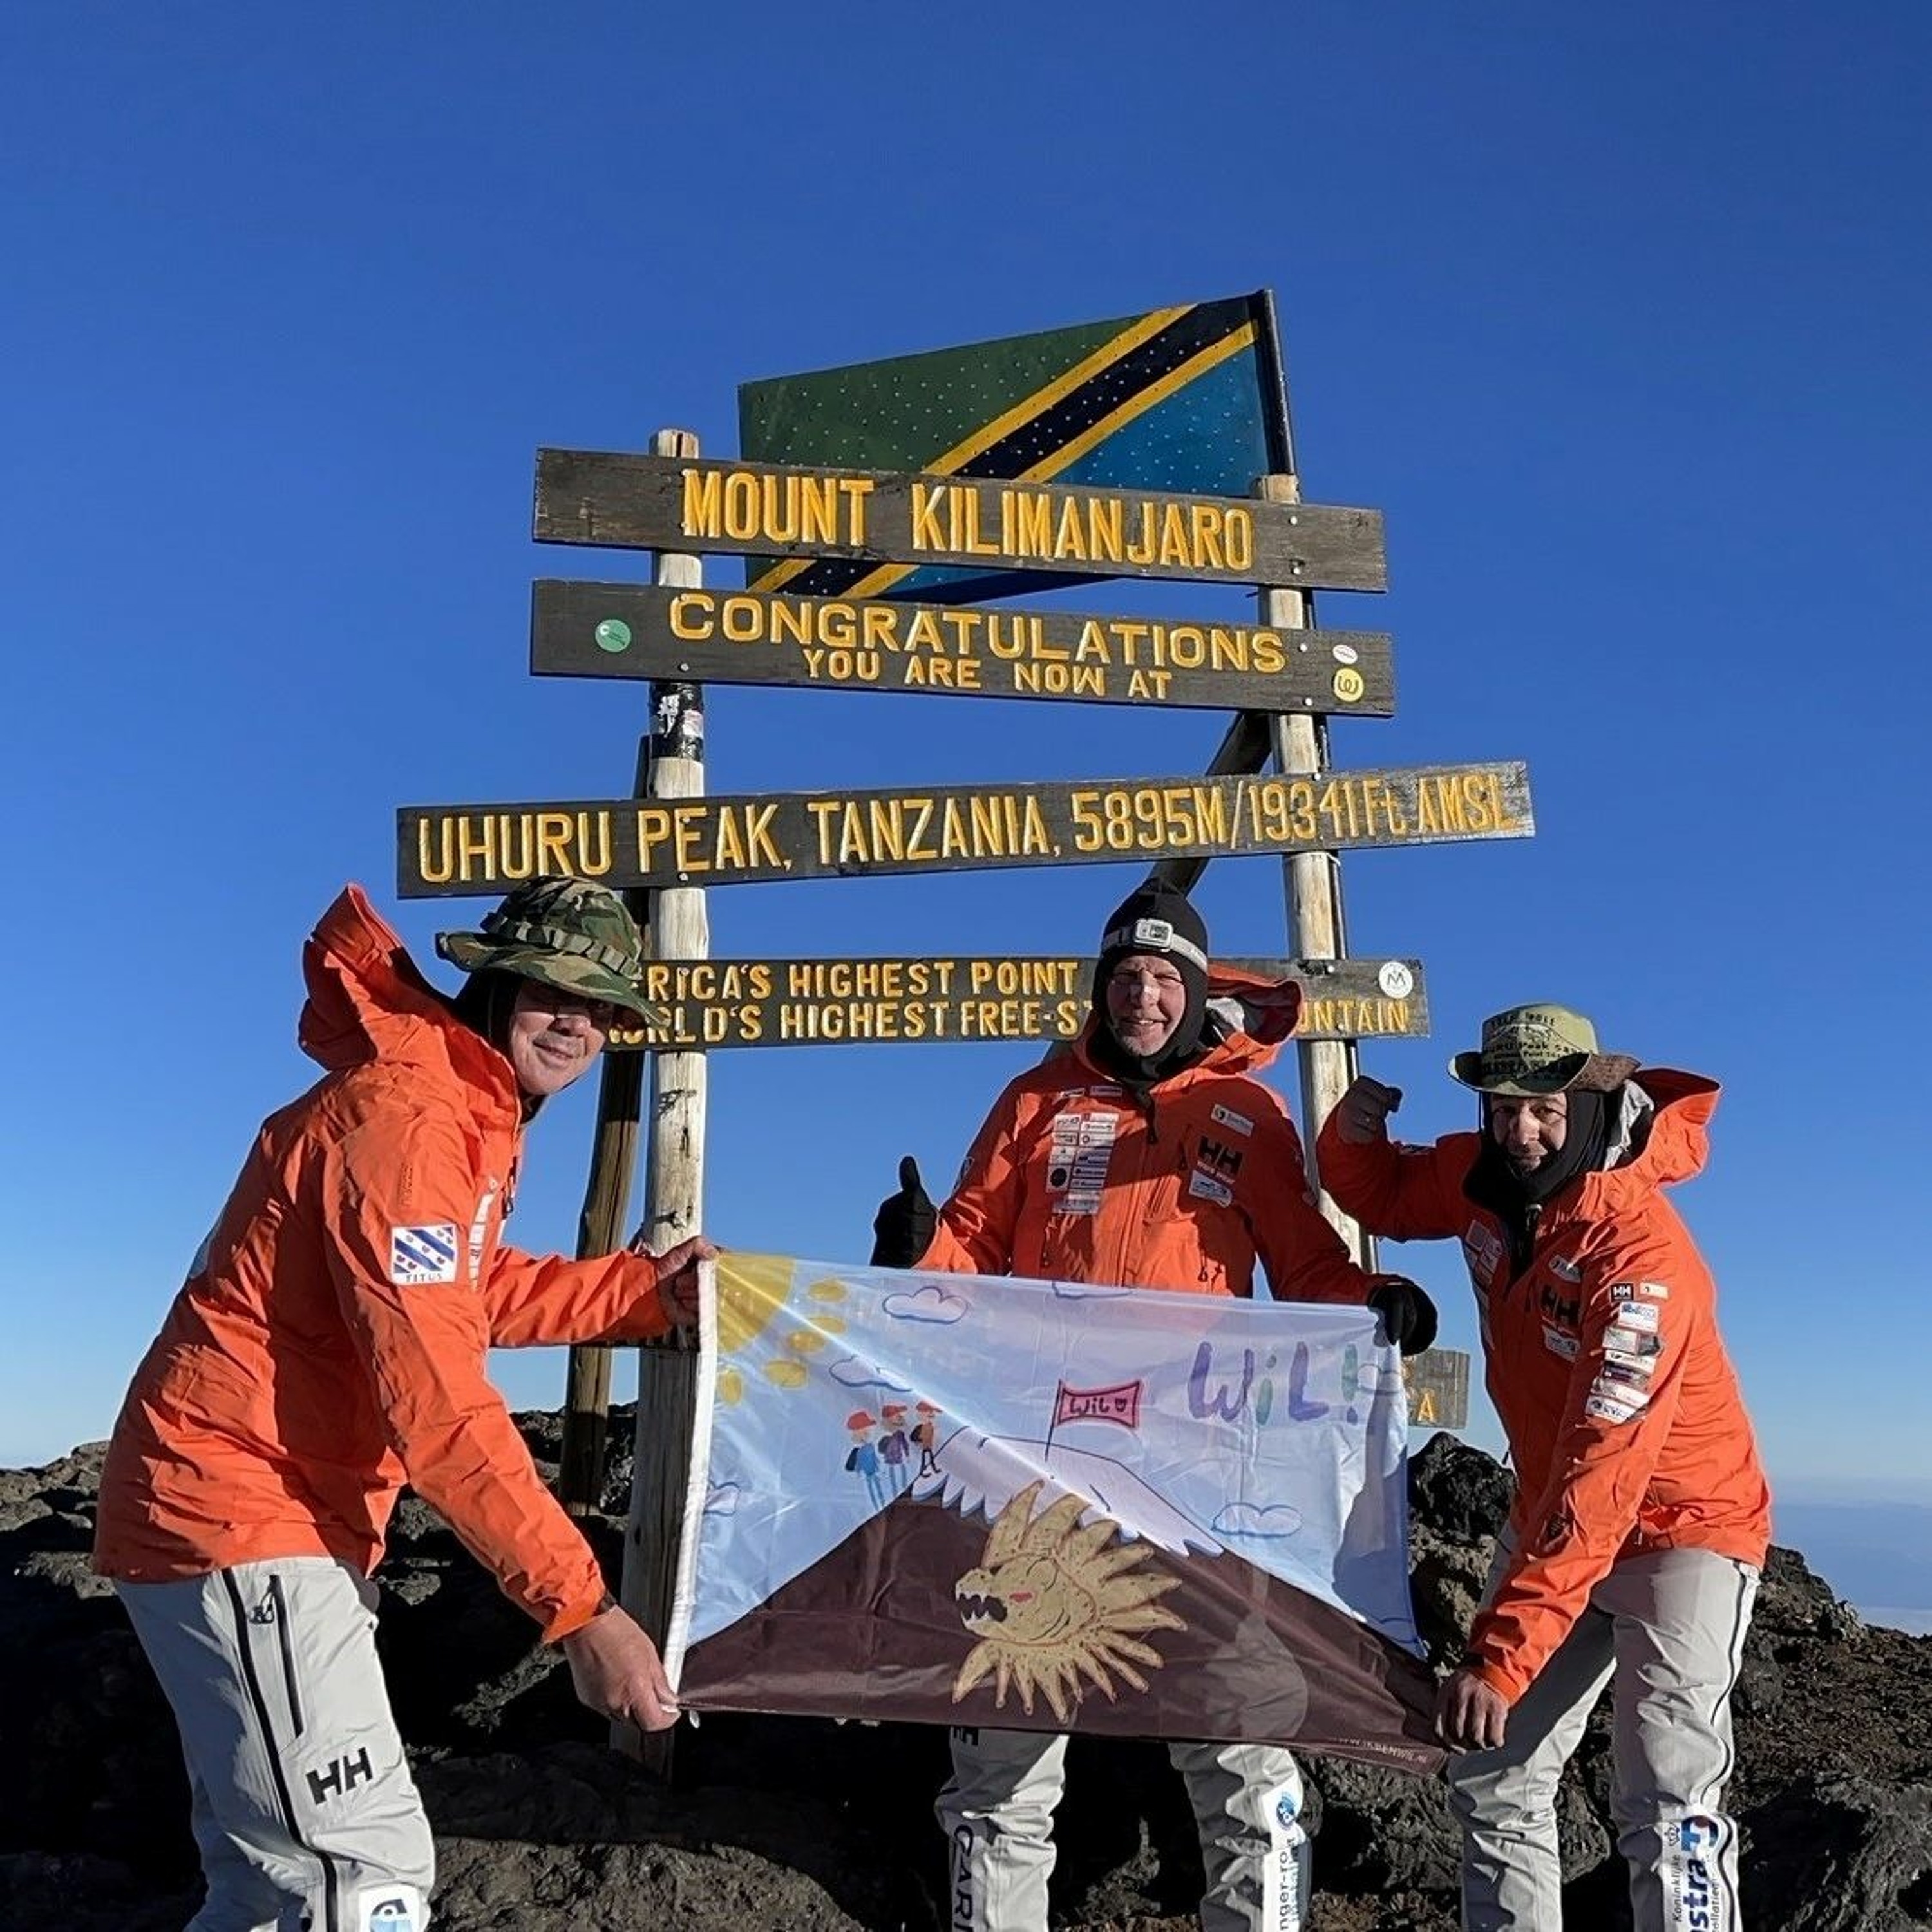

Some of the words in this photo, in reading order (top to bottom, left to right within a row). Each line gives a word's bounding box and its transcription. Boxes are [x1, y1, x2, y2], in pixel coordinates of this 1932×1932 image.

[683, 469, 874, 546] MOUNT
[911, 483, 1253, 571] KILIMANJARO
[670, 593, 1286, 674] CONGRATULATIONS
[803, 649, 880, 680] YOU
[904, 655, 981, 689] ARE
[1014, 663, 1105, 696] NOW
[1128, 670, 1172, 699] AT
[419, 811, 611, 882] UHURU
[638, 804, 793, 873] PEAK,
[808, 795, 1061, 864] TANZANIA,
[1418, 773, 1517, 833] AMSL
[648, 965, 770, 1001] RICA'S
[788, 962, 954, 998] HIGHEST
[971, 961, 1079, 995] POINT
[780, 1002, 949, 1039] HIGHEST
[960, 999, 1093, 1036] FREE-S
[1298, 999, 1408, 1033] UNTAIN
[406, 1273, 442, 1282] TITUS
[1417, 1389, 1437, 1422] A
[307, 1747, 373, 1805] HH
[1672, 1855, 1683, 1923] Koninklijke
[1684, 1859, 1709, 1932] stra
